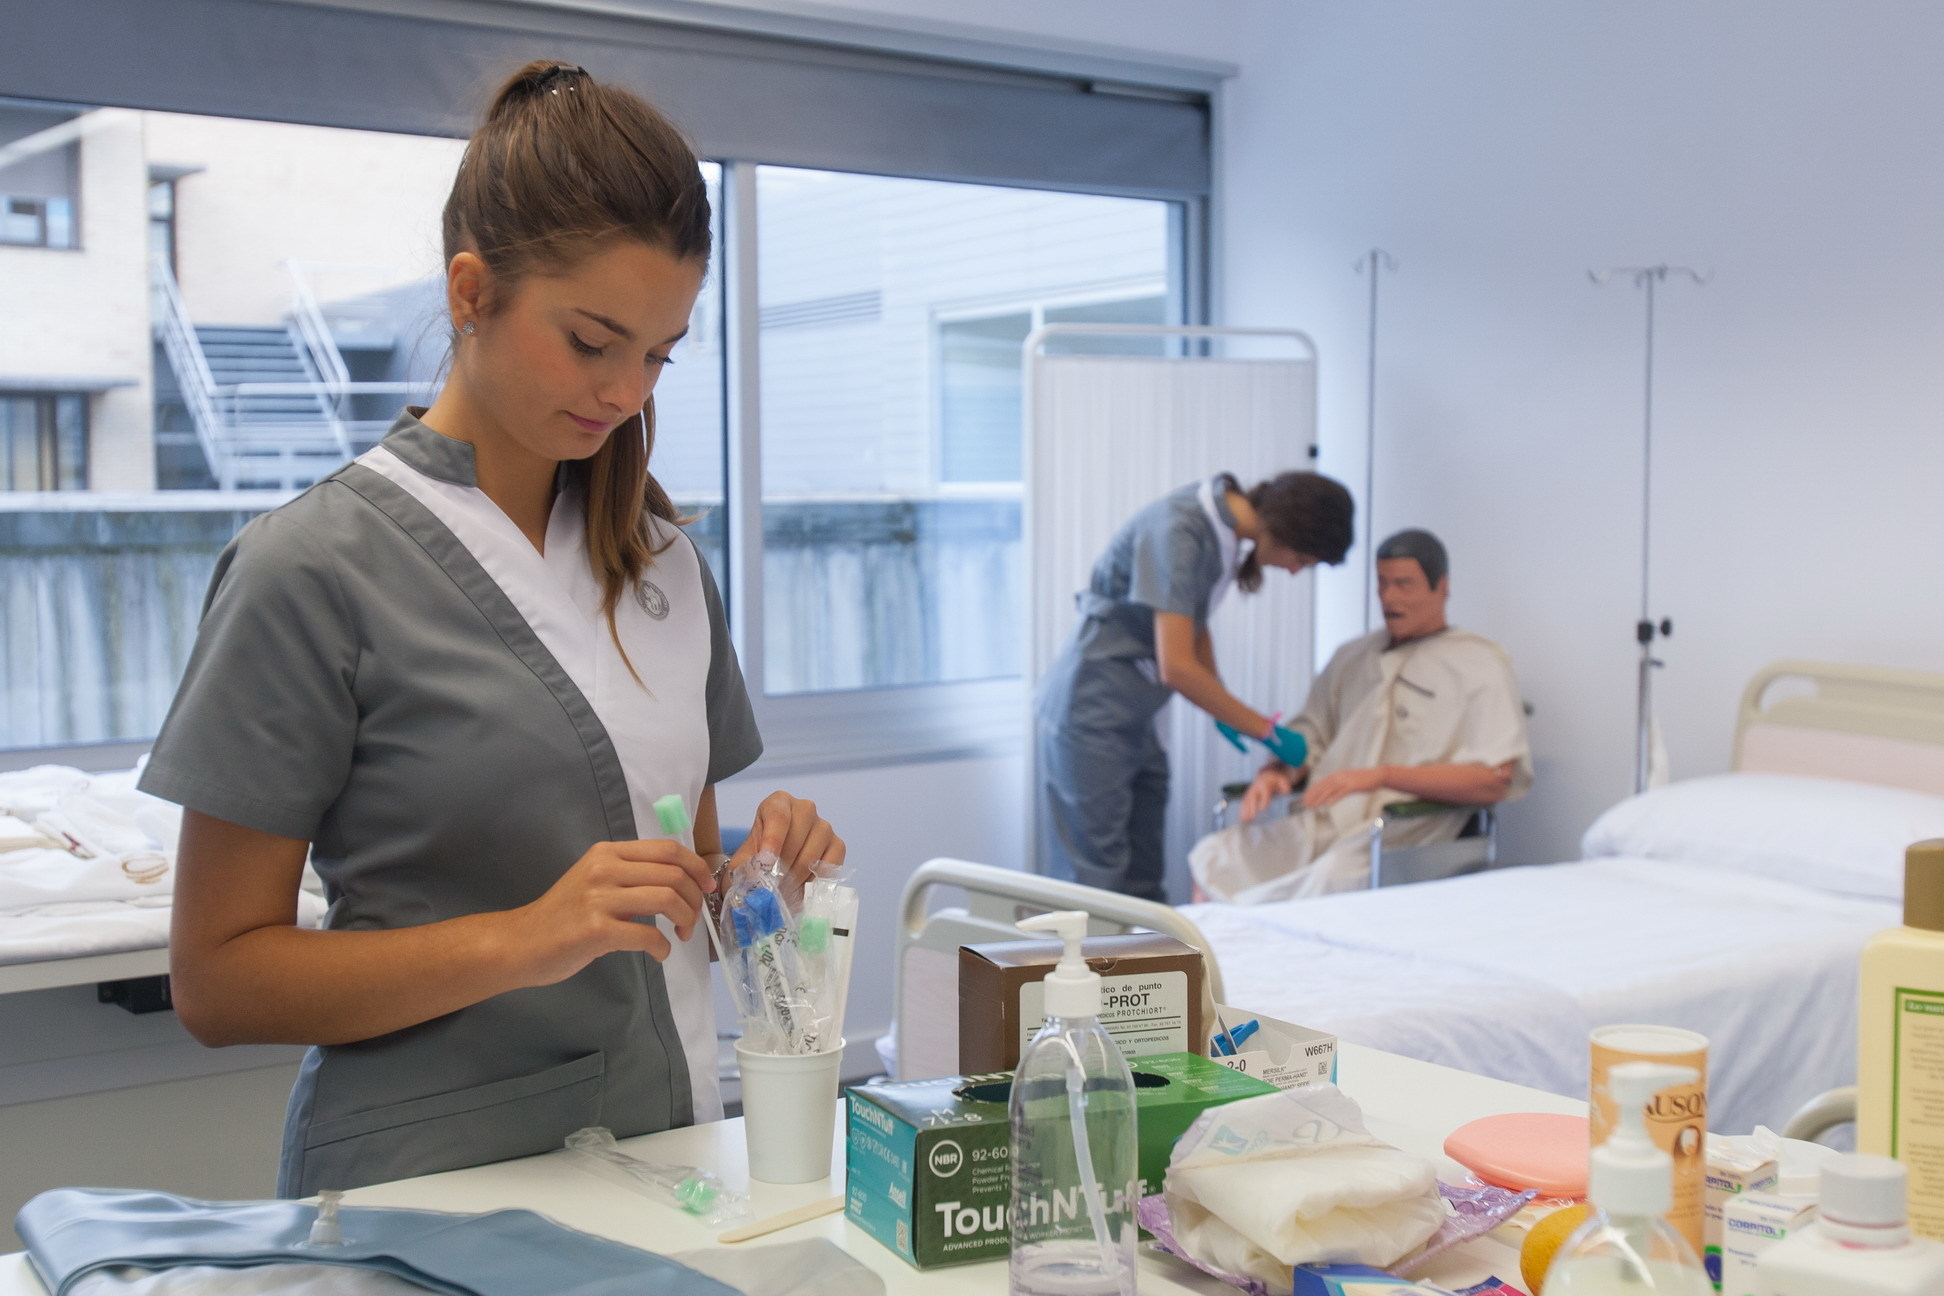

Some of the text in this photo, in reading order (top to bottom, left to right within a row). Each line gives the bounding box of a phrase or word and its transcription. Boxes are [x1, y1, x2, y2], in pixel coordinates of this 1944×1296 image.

[1122, 984, 1133, 992] de
[1138, 982, 1162, 992] punto
[1101, 993, 1150, 1008] -PROT
[1304, 1043, 1333, 1057] W667H
[1227, 1060, 1246, 1072] 2-0
[850, 1096, 894, 1136] TouchNTuff
[934, 1153, 958, 1166] NBR
[972, 1167, 1003, 1176] Chemical
[972, 1175, 998, 1185] Powder
[972, 1185, 1002, 1194] Prevents
[943, 1240, 983, 1252] ADVANCED
